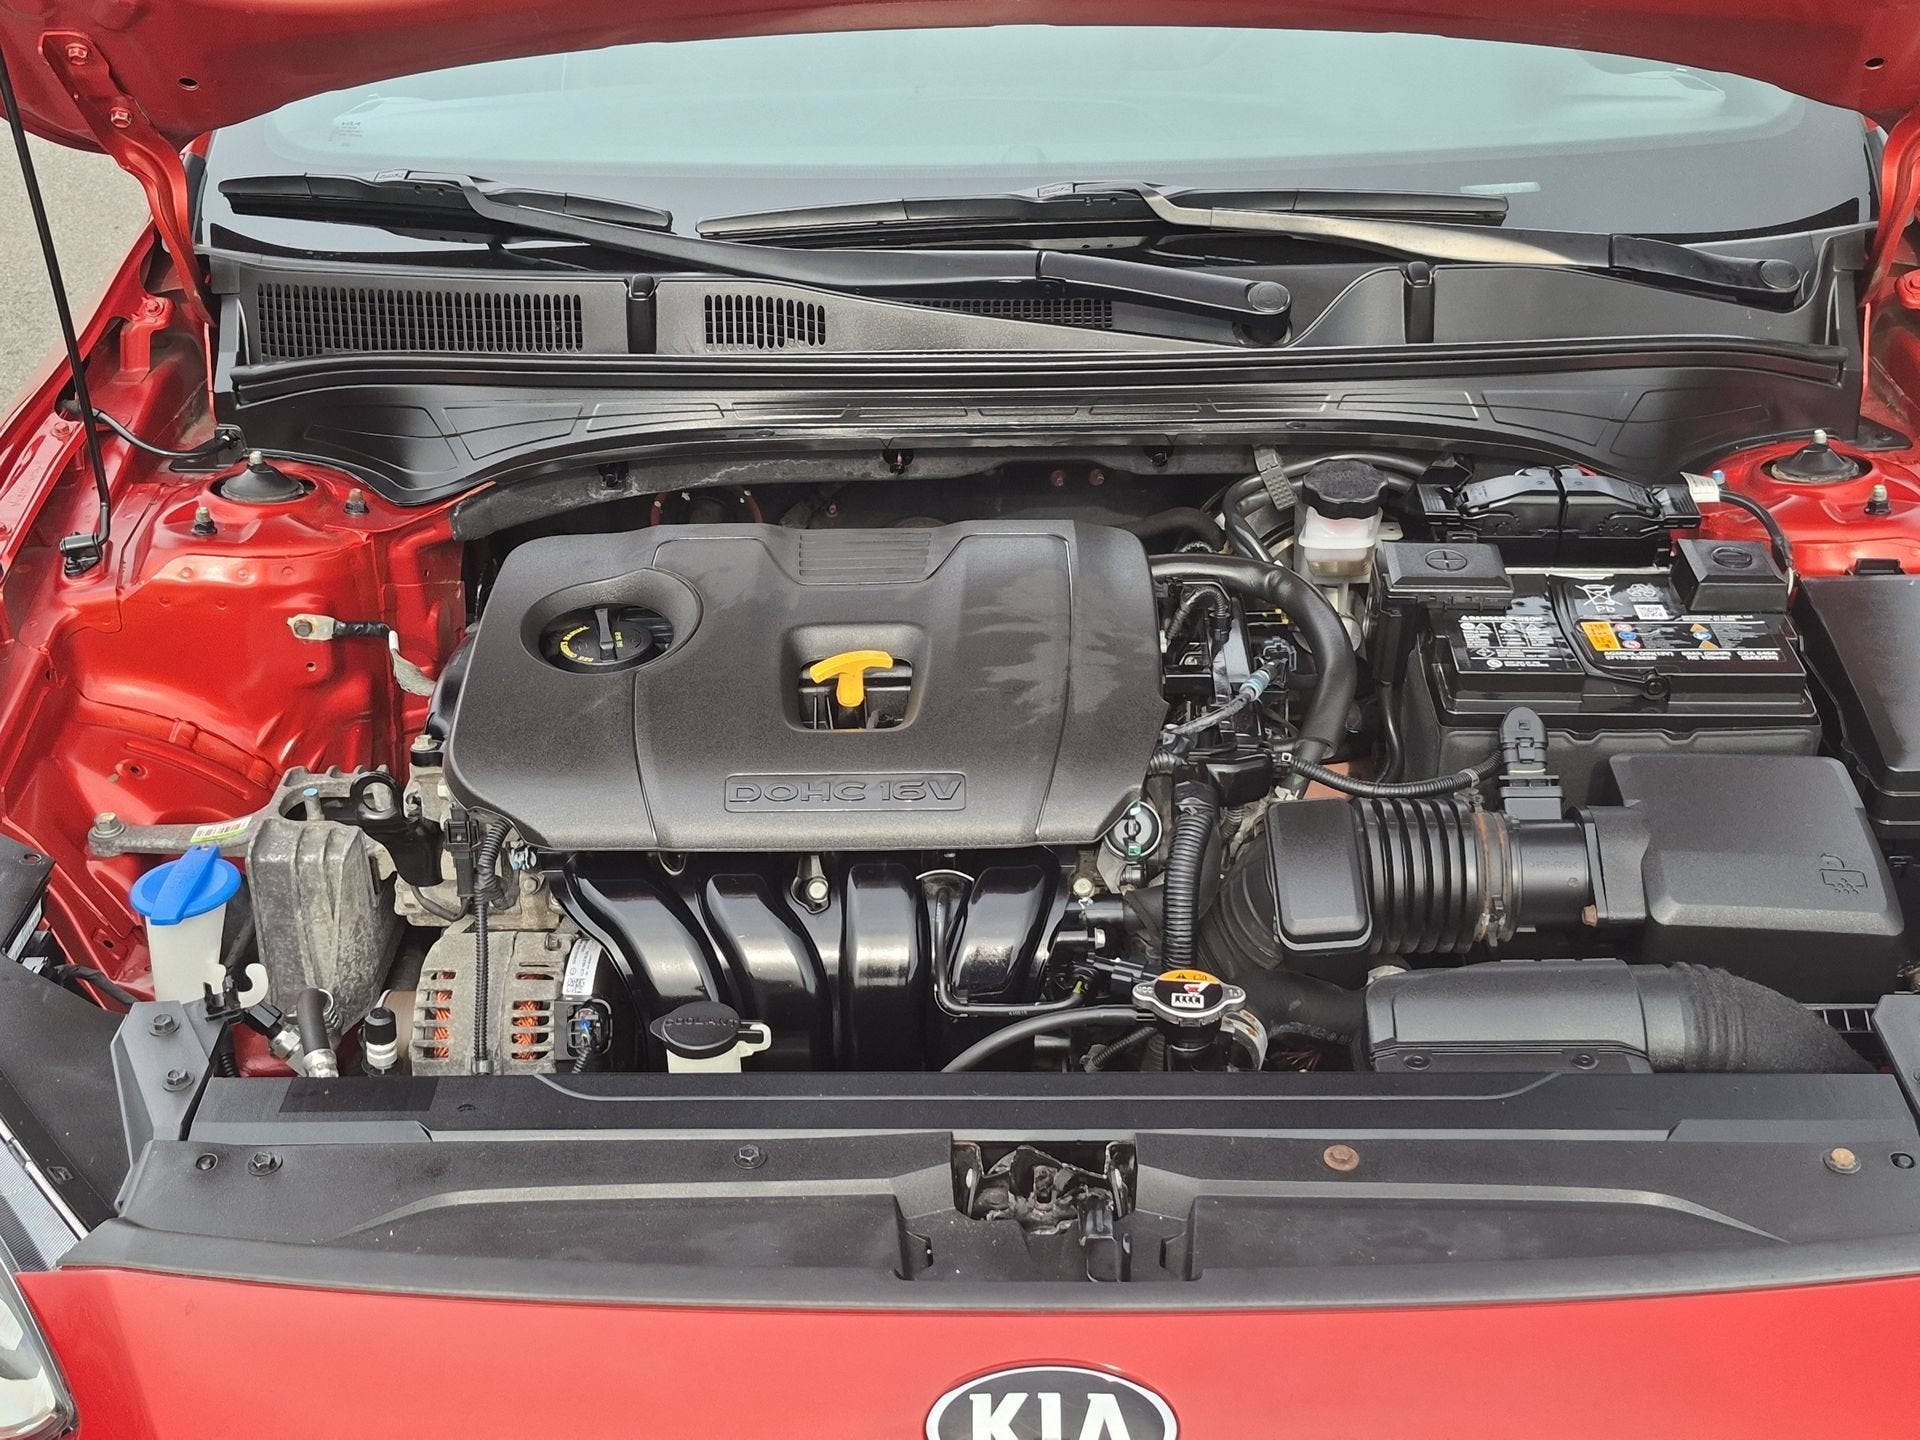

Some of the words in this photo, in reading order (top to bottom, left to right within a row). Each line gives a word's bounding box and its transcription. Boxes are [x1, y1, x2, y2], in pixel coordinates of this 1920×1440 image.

[1595, 605, 1616, 613] Pb
[729, 781, 866, 803] DOHC
[879, 780, 962, 802] 16V
[664, 1017, 739, 1028] COOLANT
[968, 1392, 1133, 1440] KIA
